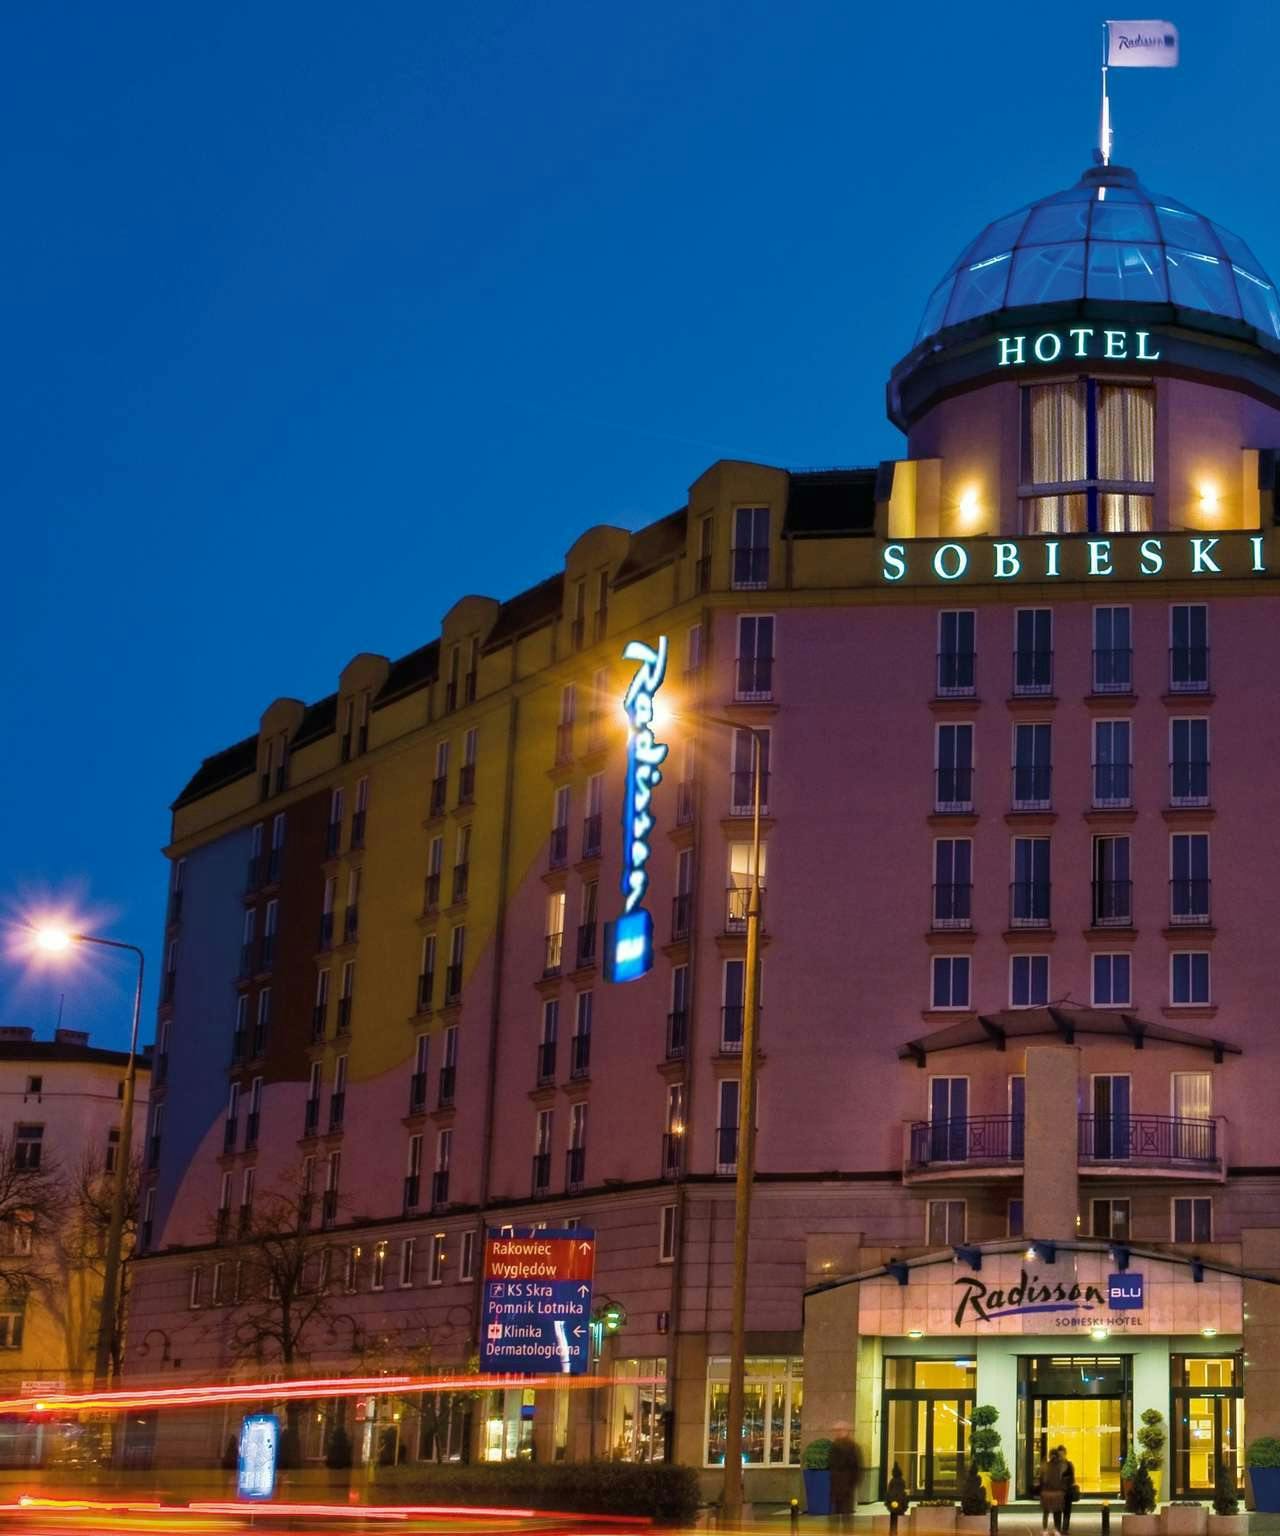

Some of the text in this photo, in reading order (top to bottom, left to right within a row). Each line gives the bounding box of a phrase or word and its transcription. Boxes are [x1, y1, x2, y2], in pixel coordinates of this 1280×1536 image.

[998, 328, 1161, 366] HOTEL
[881, 535, 1267, 581] SOBIESKI
[622, 635, 669, 912] Radisson
[493, 1242, 552, 1255] Rakowiec
[492, 1262, 557, 1278] Wyględów
[507, 1284, 553, 1297] KS Skra
[955, 1270, 1141, 1327] Radisson BLU
[489, 1301, 584, 1314] Pomnik Lotnika
[1056, 1316, 1143, 1327] SOBIESKI HOTEL
[504, 1324, 542, 1338] Klinika
[486, 1343, 580, 1359] Dermatologicna
